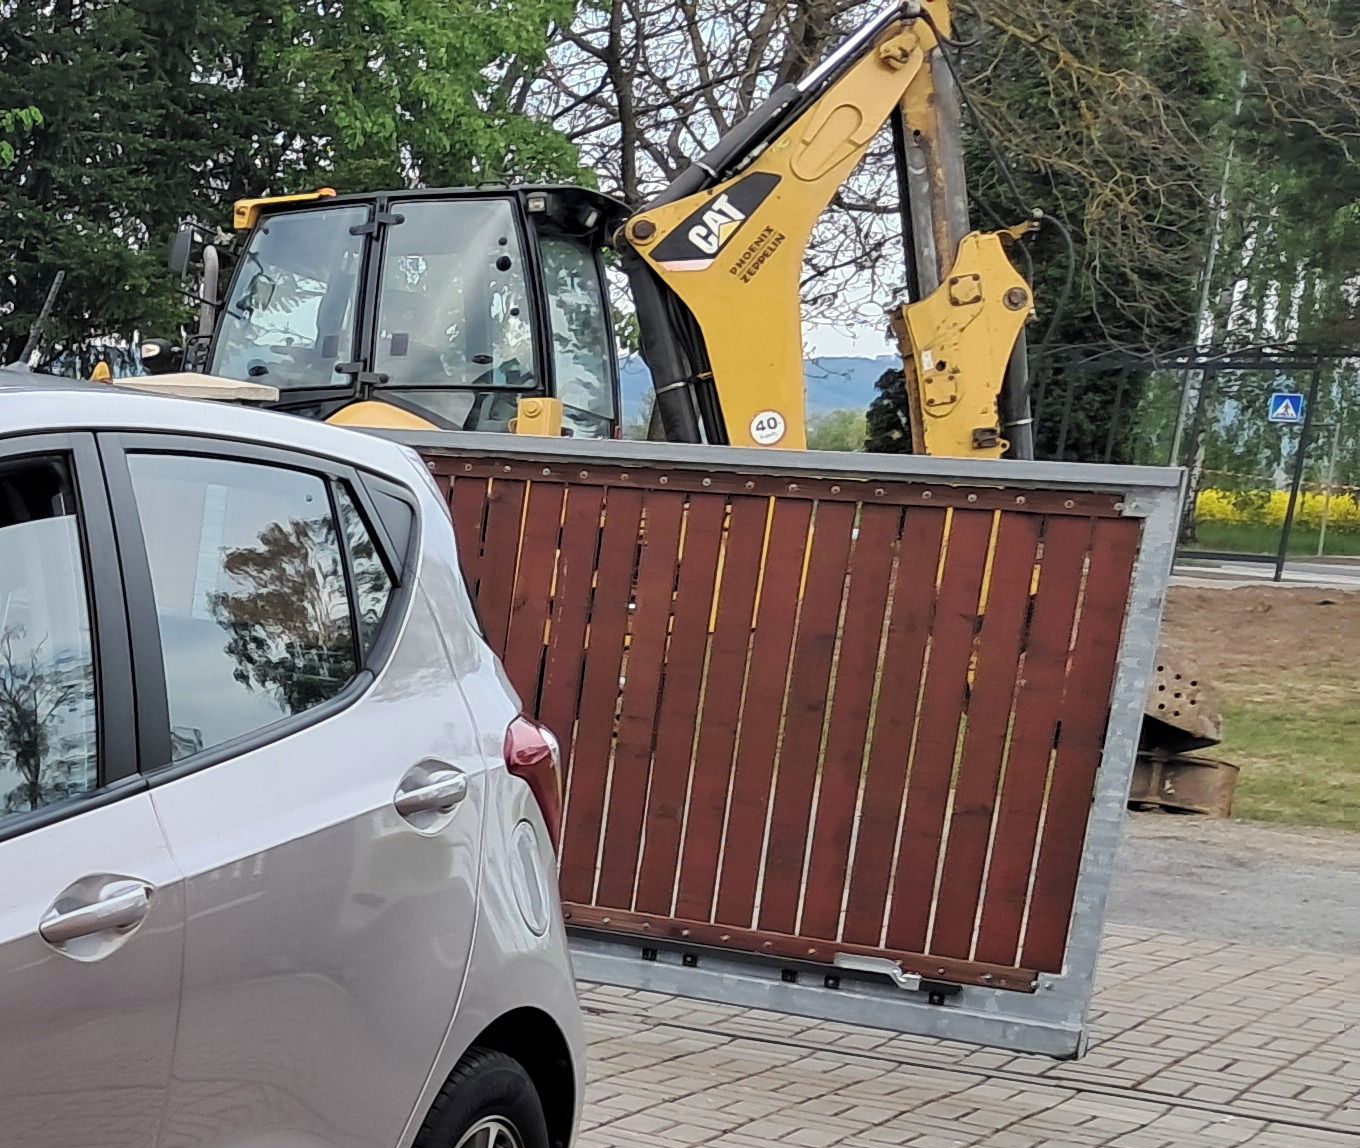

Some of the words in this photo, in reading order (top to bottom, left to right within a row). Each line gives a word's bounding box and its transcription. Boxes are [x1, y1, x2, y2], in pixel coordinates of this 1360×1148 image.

[688, 193, 746, 255] CAT
[729, 225, 774, 276] PHOENIX
[740, 232, 786, 284] ZEPPELIN
[755, 416, 778, 432] 40
